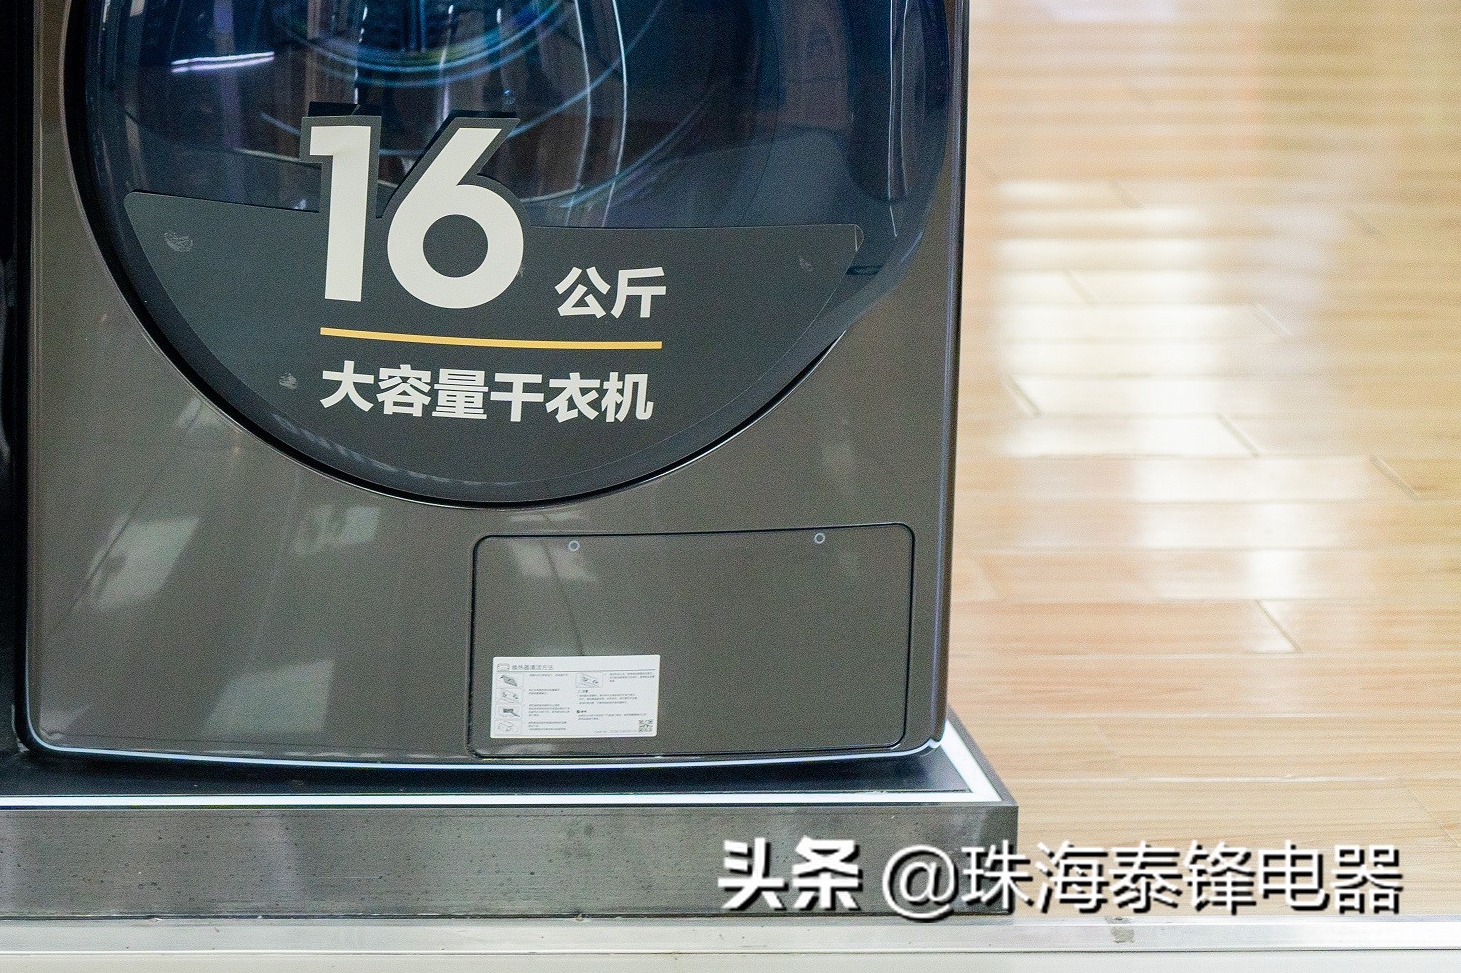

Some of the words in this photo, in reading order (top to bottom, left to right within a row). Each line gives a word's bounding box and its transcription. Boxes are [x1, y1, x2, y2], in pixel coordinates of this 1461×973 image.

[309, 125, 524, 309] 16
[554, 266, 667, 319] 公斤
[319, 360, 654, 423] 大容量干衣机
